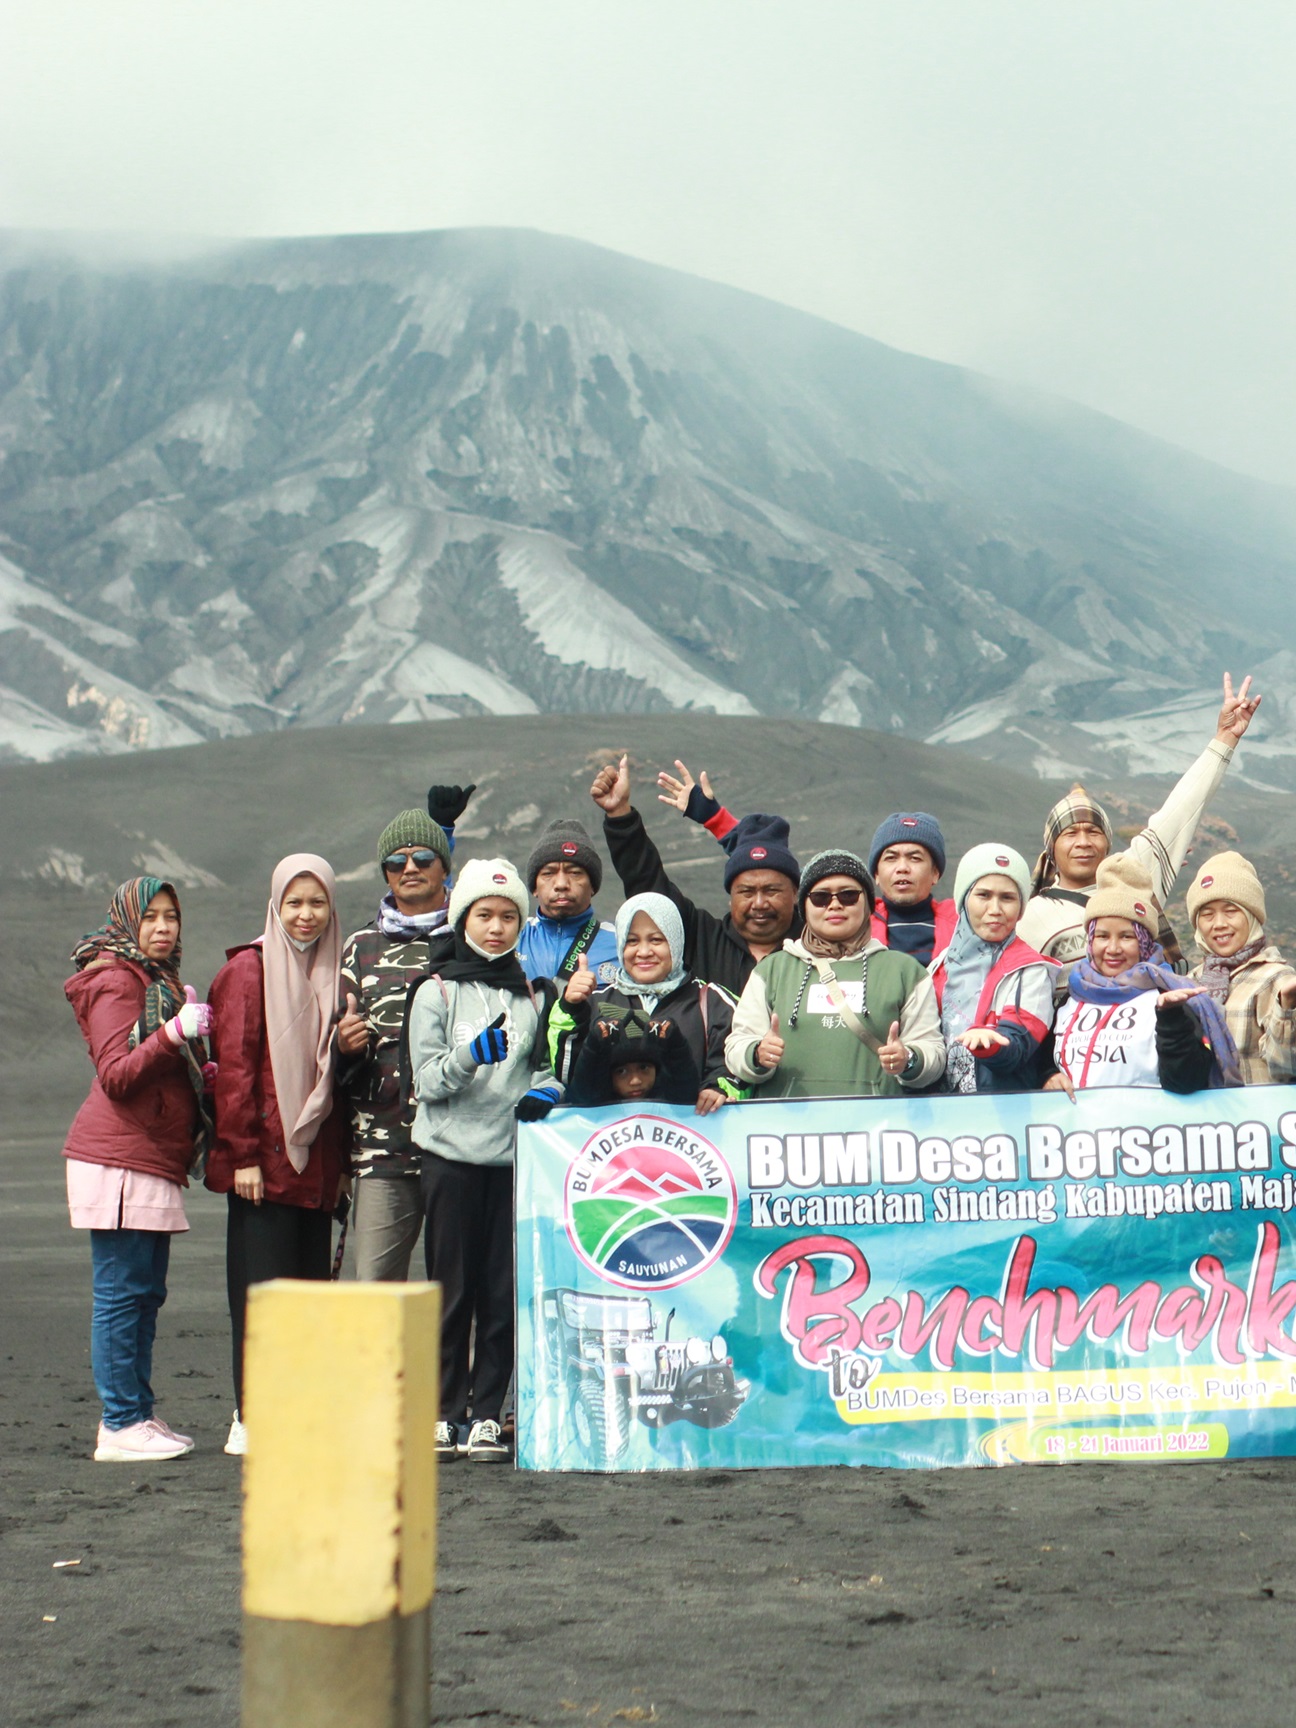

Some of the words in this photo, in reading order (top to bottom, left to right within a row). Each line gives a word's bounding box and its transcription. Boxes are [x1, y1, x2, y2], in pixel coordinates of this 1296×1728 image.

[565, 940, 586, 972] pierre
[572, 1150, 604, 1193] BUM
[598, 1124, 645, 1156] DESA
[651, 1125, 724, 1190] BERSAMA
[747, 1131, 872, 1189] BUM
[879, 1130, 1019, 1184] Desa
[1025, 1120, 1273, 1182] Bersama
[749, 1188, 926, 1228] Kecamatan
[932, 1185, 1057, 1224] Sindang
[1064, 1177, 1233, 1220] Kabupaten
[618, 1253, 688, 1276] SAUYUNAN
[822, 1348, 879, 1397] to
[848, 1387, 946, 1411] BUMDes
[952, 1386, 1049, 1407] Bersama
[1057, 1383, 1142, 1404] BAGUS
[1080, 1436, 1098, 1453] 21
[1103, 1434, 1163, 1454] Januari
[1166, 1432, 1209, 1451] 2022
